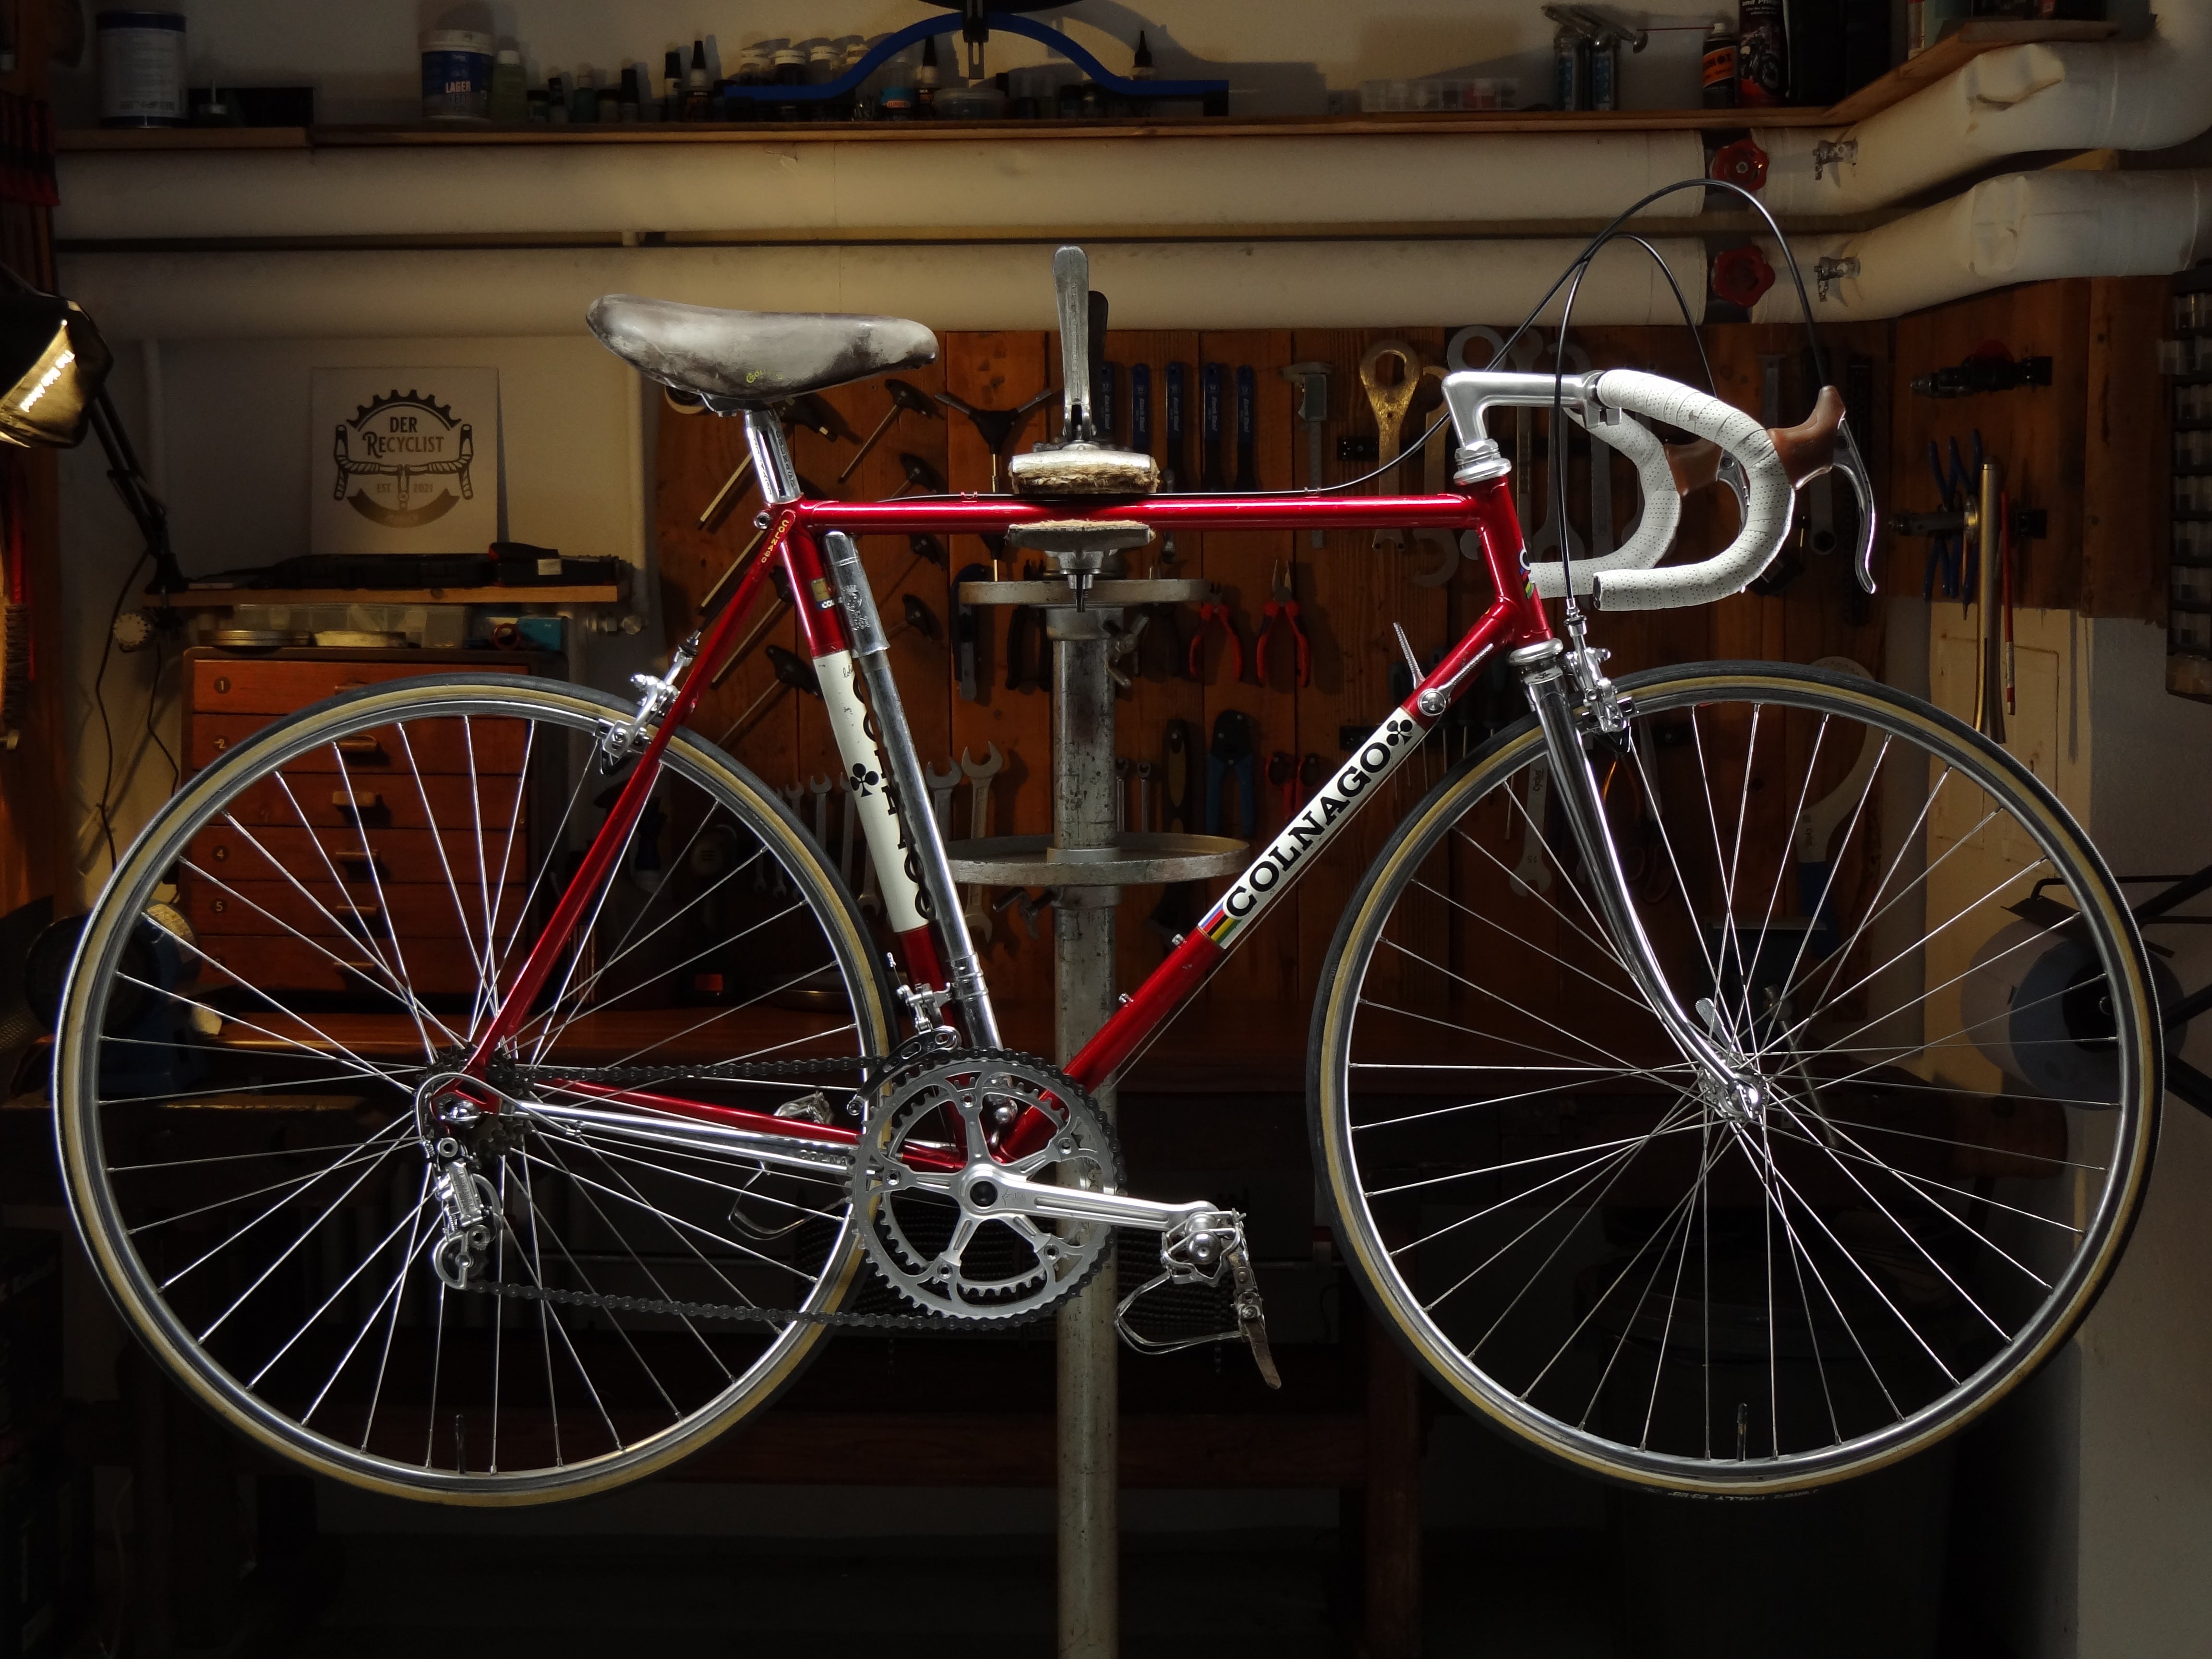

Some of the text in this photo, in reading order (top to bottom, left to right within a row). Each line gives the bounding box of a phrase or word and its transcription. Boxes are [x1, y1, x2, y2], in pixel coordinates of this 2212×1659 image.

[445, 81, 471, 94] LAGER
[389, 417, 418, 433] DER
[761, 519, 789, 563] COLNAGO
[1532, 768, 1544, 792] Cyclus
[1226, 742, 1391, 917] COLNAGO
[216, 849, 224, 859] 4
[216, 901, 223, 912] 5
